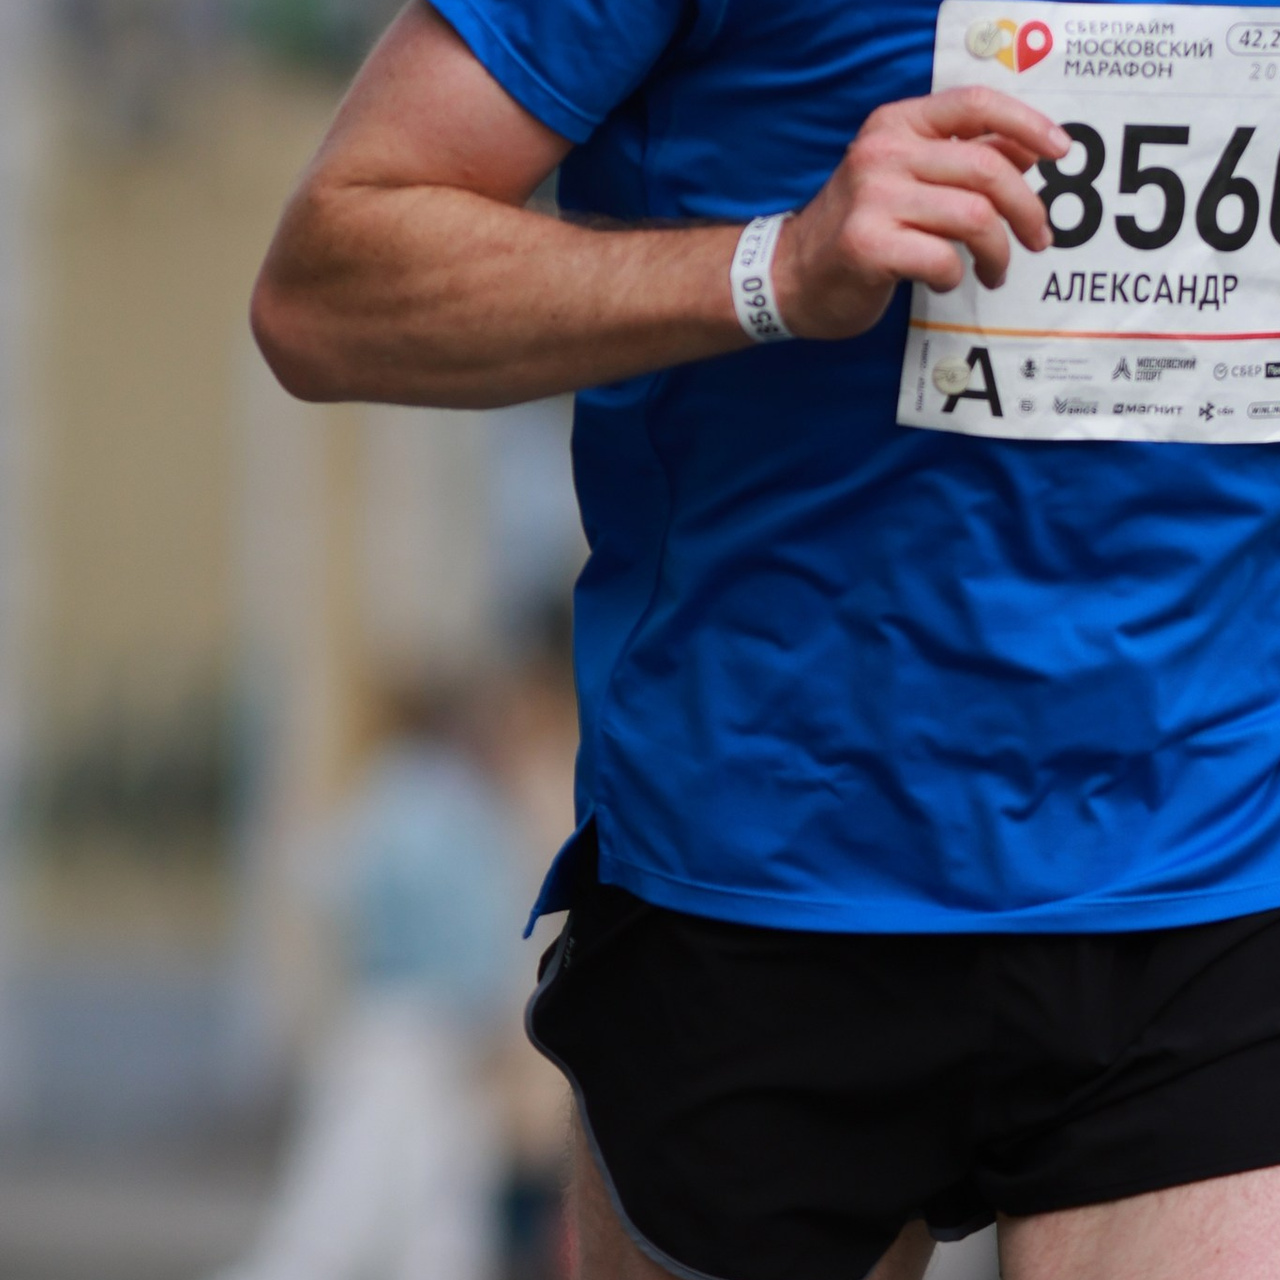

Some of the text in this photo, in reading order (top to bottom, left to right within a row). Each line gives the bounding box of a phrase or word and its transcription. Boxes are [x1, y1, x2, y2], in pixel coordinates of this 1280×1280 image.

[1064, 19, 1175, 35] СБЕРПРАЙМ
[1065, 37, 1214, 58] МОСКОВСКИЙ
[1063, 60, 1174, 78] МАРАФОН
[1041, 271, 1239, 312] АЛЕКСАНДР
